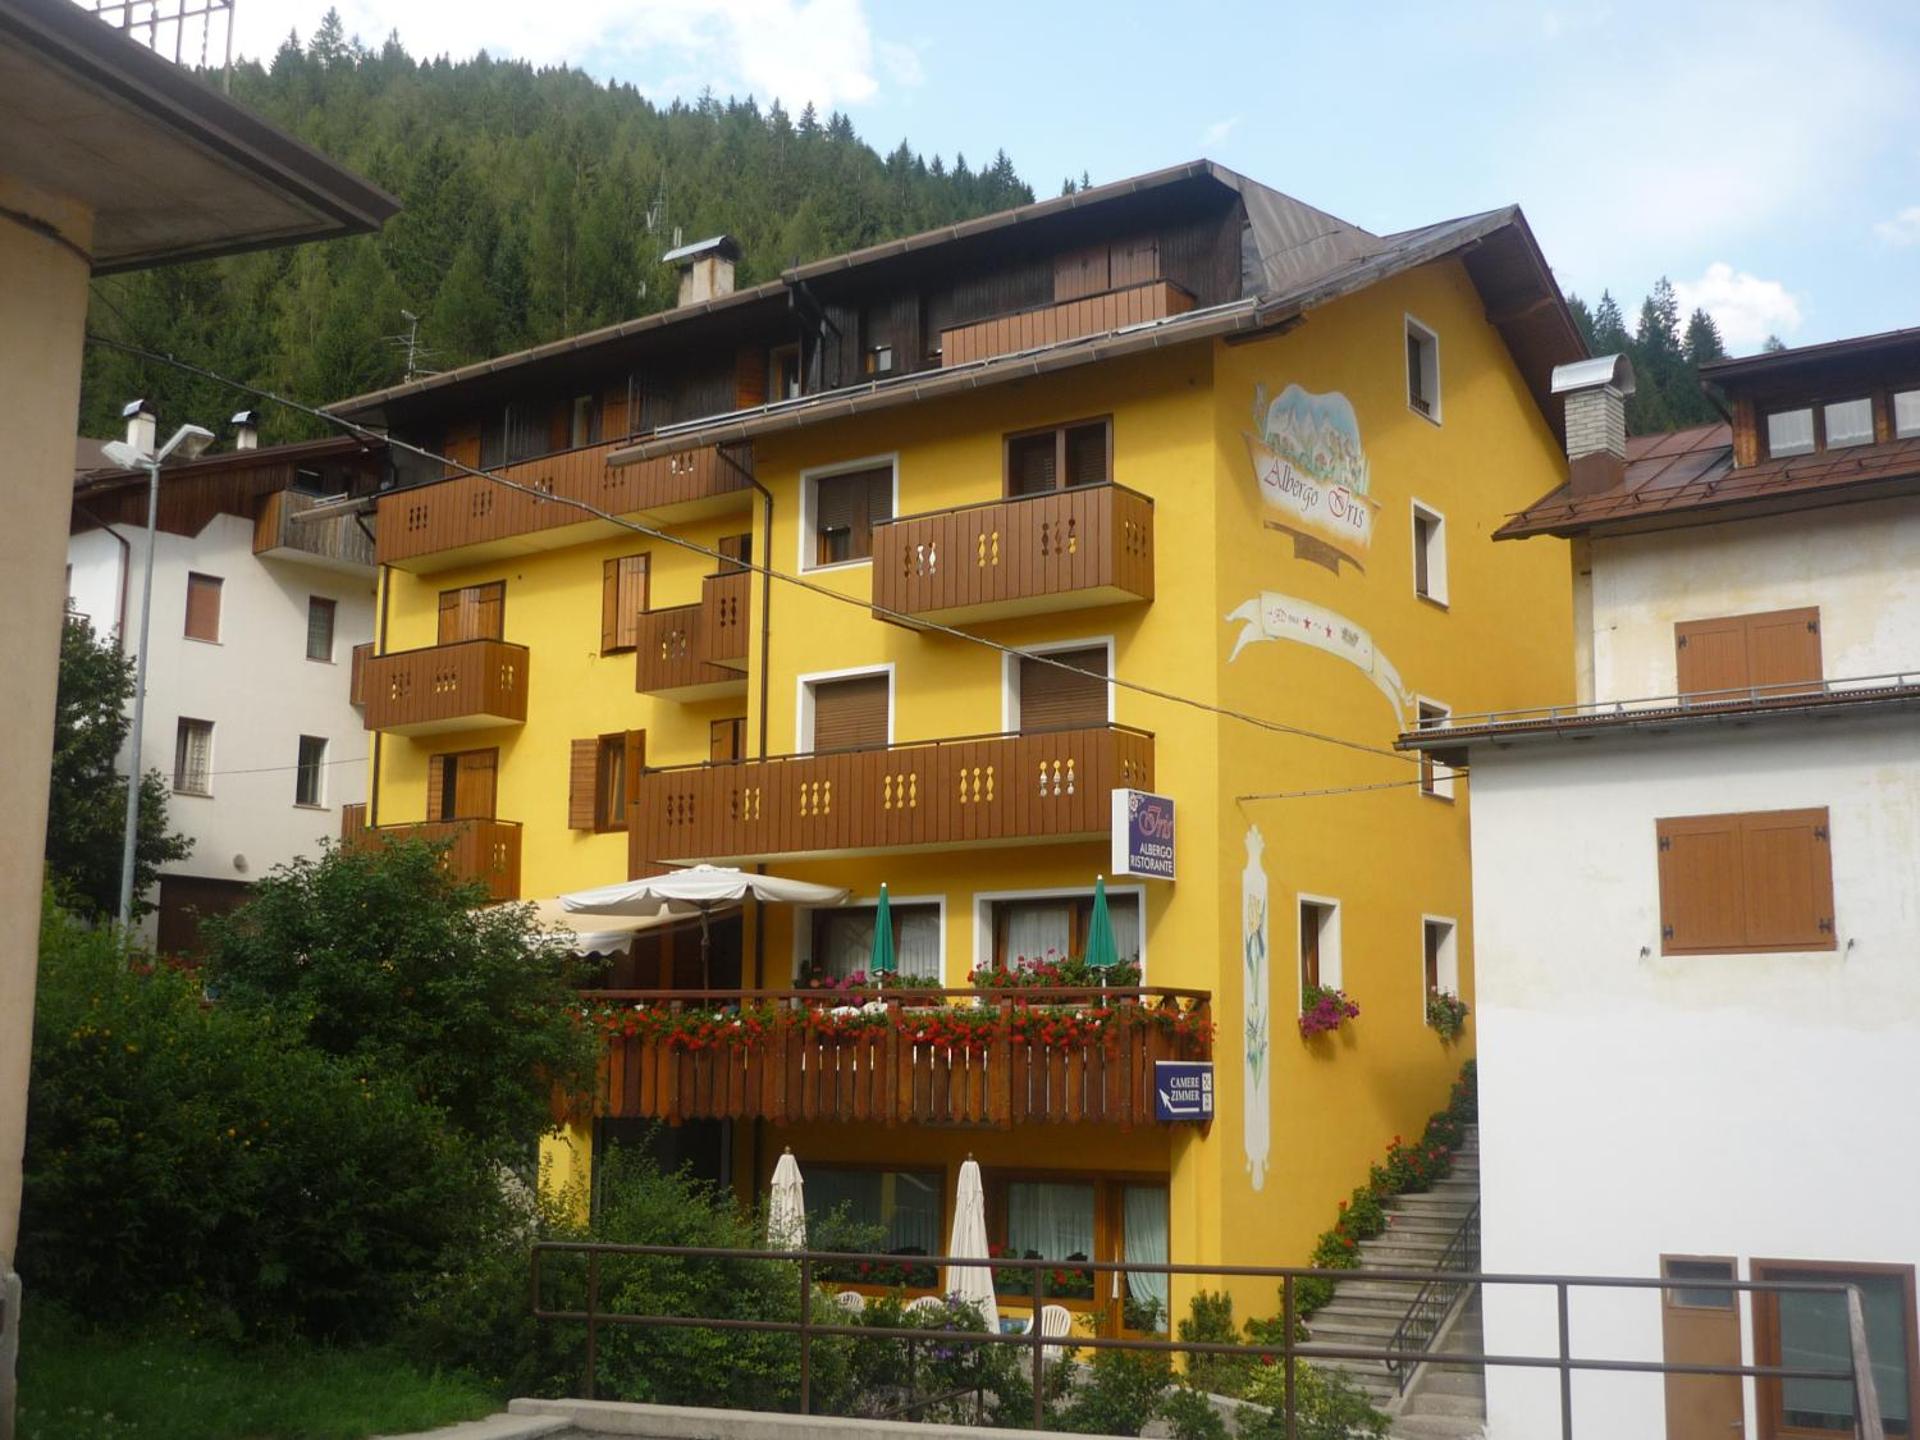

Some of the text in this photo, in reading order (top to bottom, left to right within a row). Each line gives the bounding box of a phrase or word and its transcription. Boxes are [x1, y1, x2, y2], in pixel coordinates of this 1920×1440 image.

[1263, 459, 1364, 528] Albergo Iris
[1140, 842, 1172, 860] ALBERGO
[1130, 854, 1173, 873] RISTORANTE
[1170, 1076, 1200, 1089] CAMERE
[1170, 1089, 1200, 1102] ZIMMER
